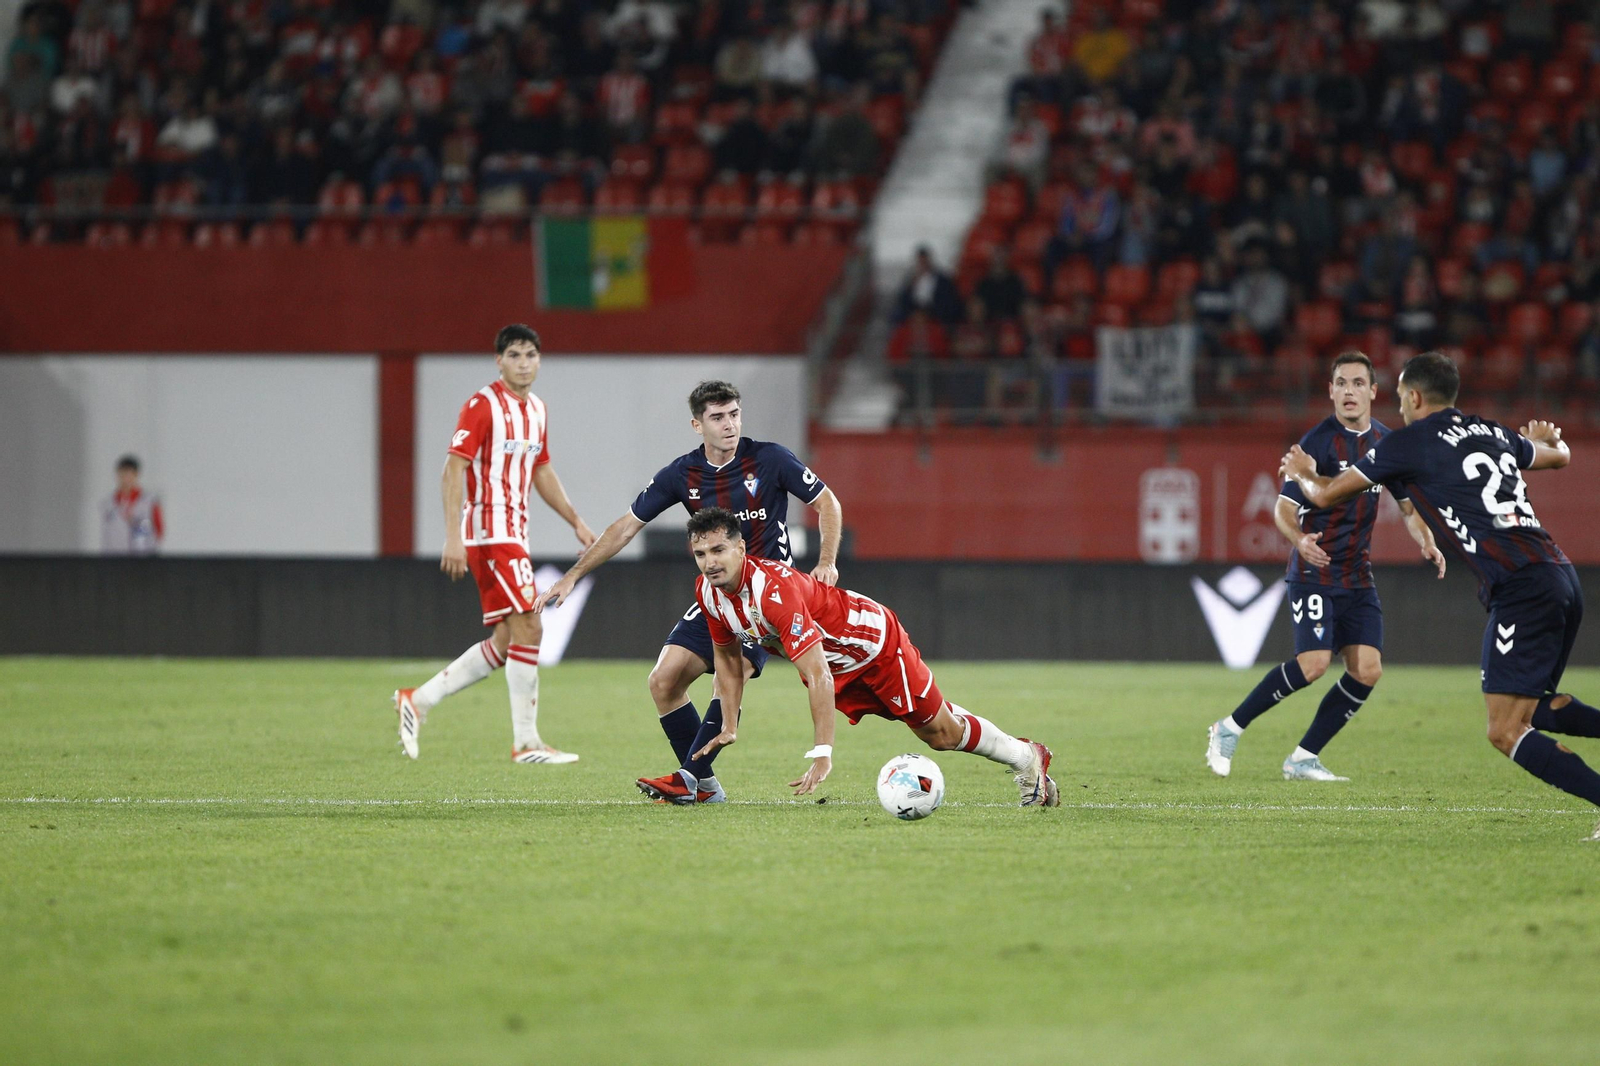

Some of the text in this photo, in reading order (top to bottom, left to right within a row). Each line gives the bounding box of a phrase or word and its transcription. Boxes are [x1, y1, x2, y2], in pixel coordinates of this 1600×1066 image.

[1462, 451, 1535, 515] 22
[734, 507, 767, 521] rtlog
[508, 557, 534, 587] 18
[1307, 593, 1324, 620] 9
